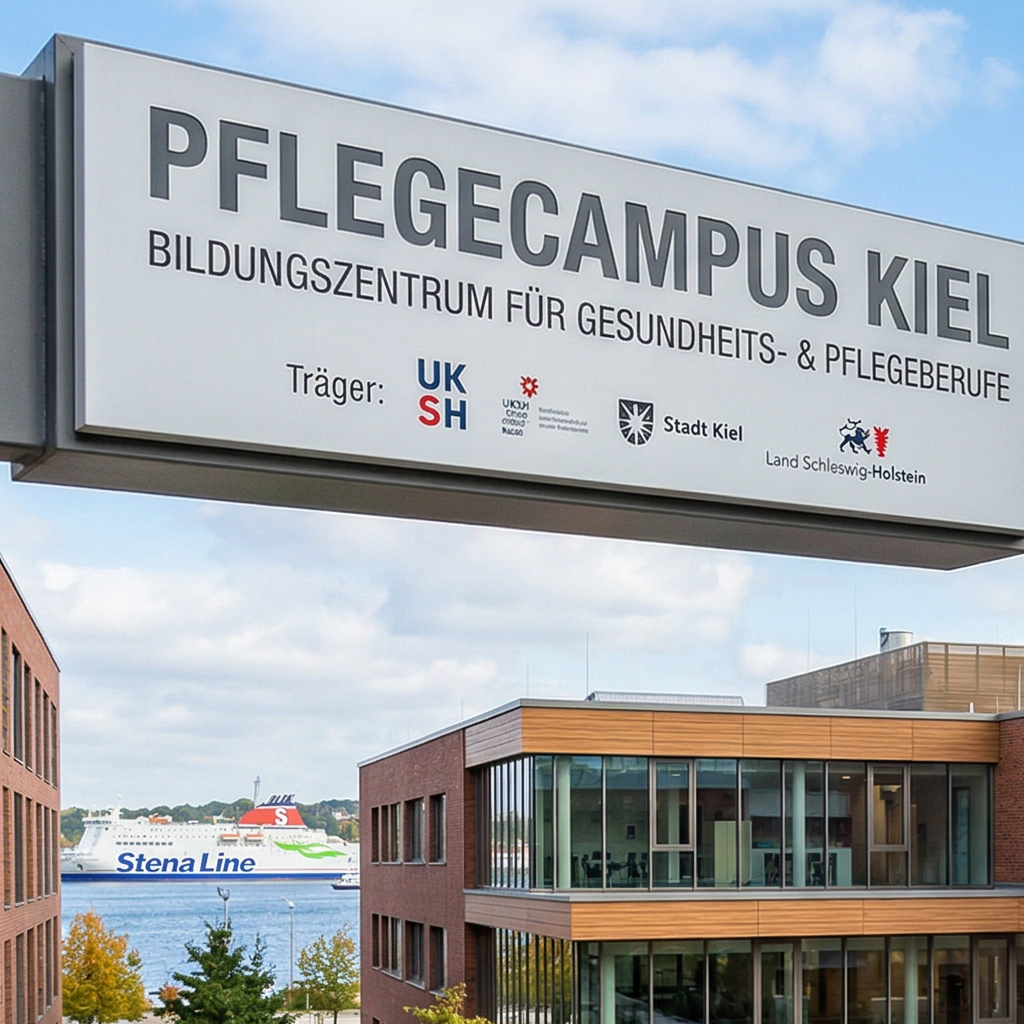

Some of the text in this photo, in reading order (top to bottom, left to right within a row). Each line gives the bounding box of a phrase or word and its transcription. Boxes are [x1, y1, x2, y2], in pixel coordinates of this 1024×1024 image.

[149, 105, 1010, 350] PFLEGECAMPUS KIEL
[149, 229, 1011, 403] BILDUNGSZENTRUM FÜR GESUNDHEITS- & PFLEGEBERUFE
[286, 363, 384, 408] Träger:
[417, 358, 467, 395] UK
[418, 394, 467, 431] SH
[663, 415, 743, 442] Stadt Kiel
[766, 451, 926, 485] Land Schleswig-Holstein
[274, 807, 289, 826] S
[116, 852, 256, 873] Stena Line
